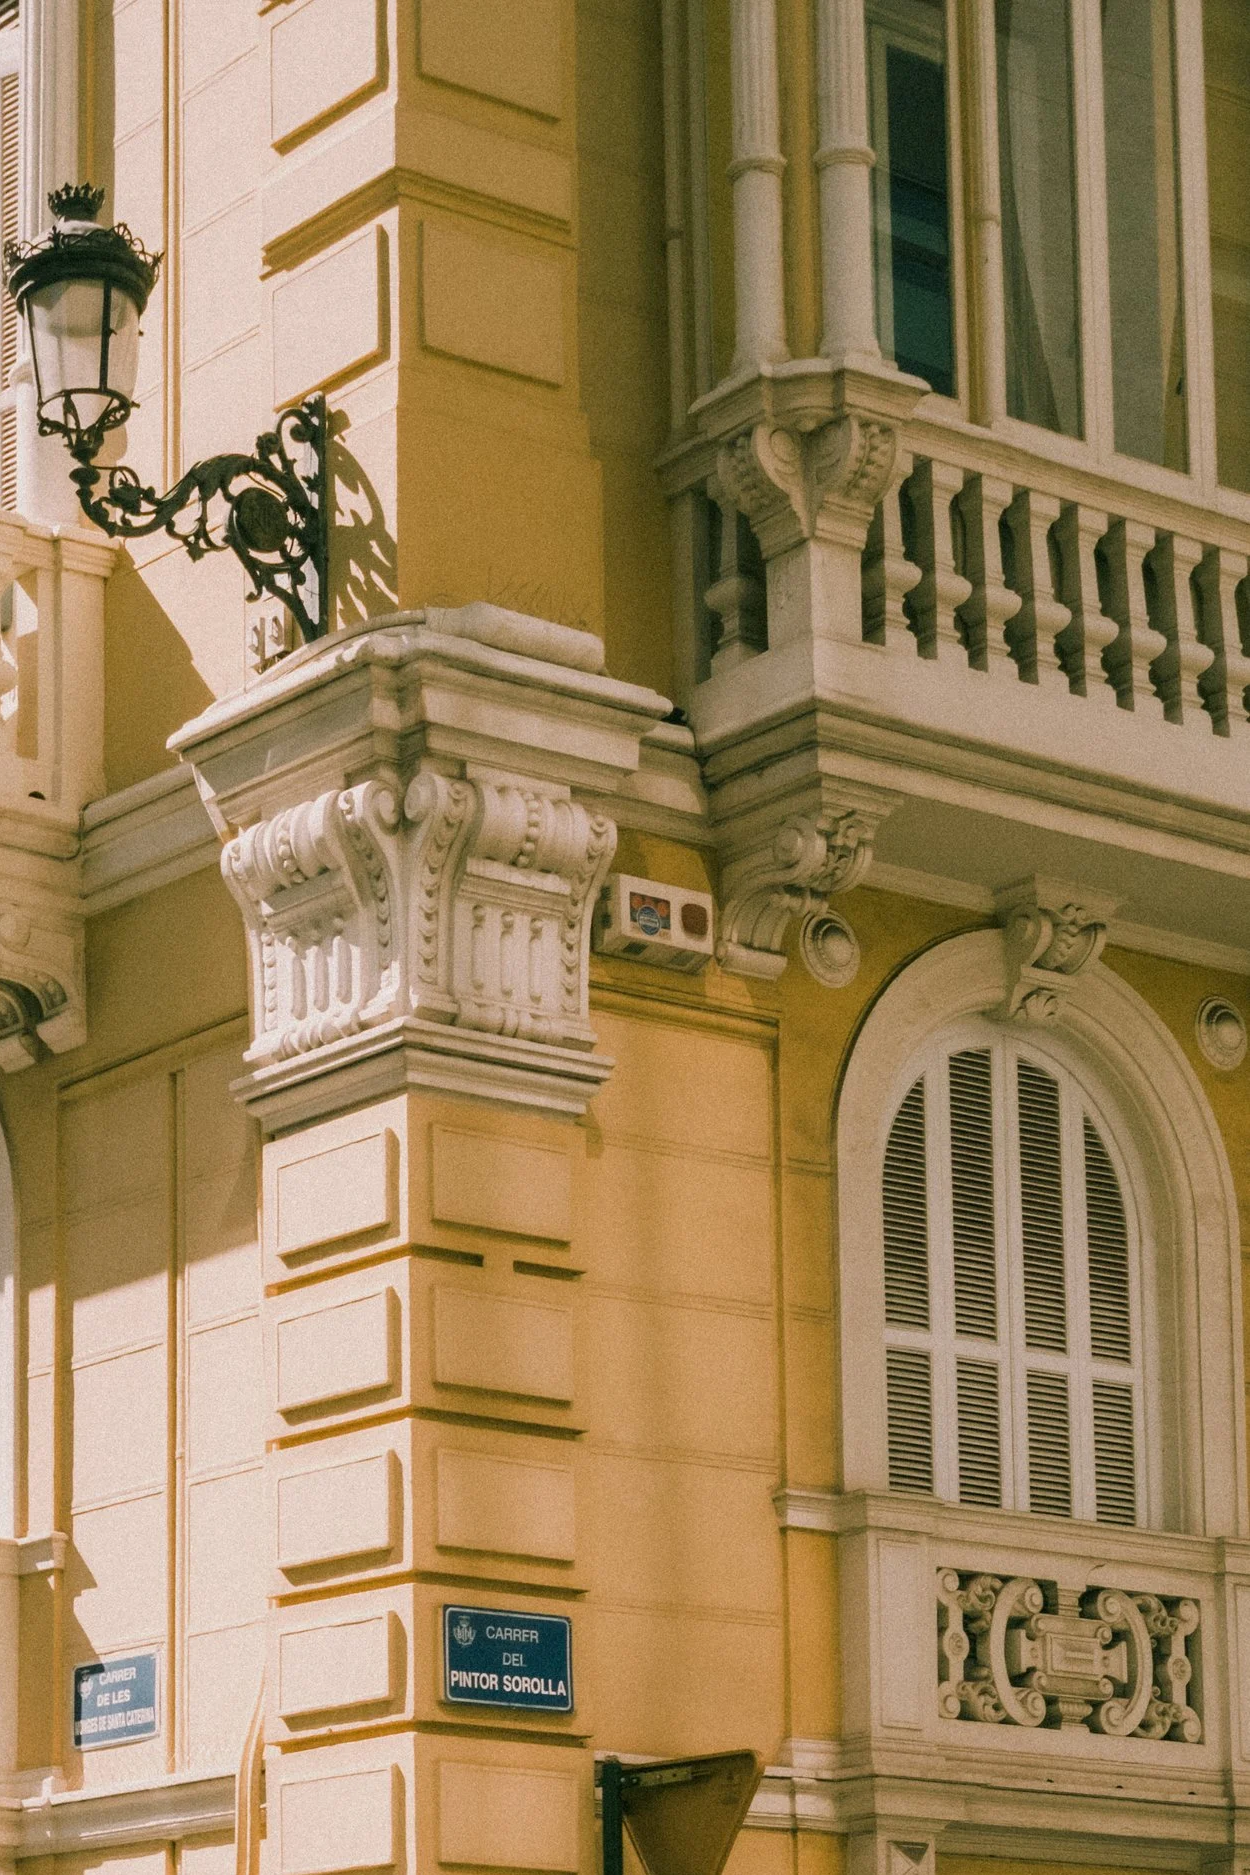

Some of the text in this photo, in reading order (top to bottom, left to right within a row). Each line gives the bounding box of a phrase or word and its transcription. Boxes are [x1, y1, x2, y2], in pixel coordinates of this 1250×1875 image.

[486, 1626, 539, 1643] CARRER
[502, 1652, 527, 1667] DEL
[99, 1667, 136, 1685] CARRER
[450, 1670, 567, 1697] PINTOR SOROLLA
[97, 1689, 130, 1706] DE LES
[107, 1711, 126, 1730] SANTA
